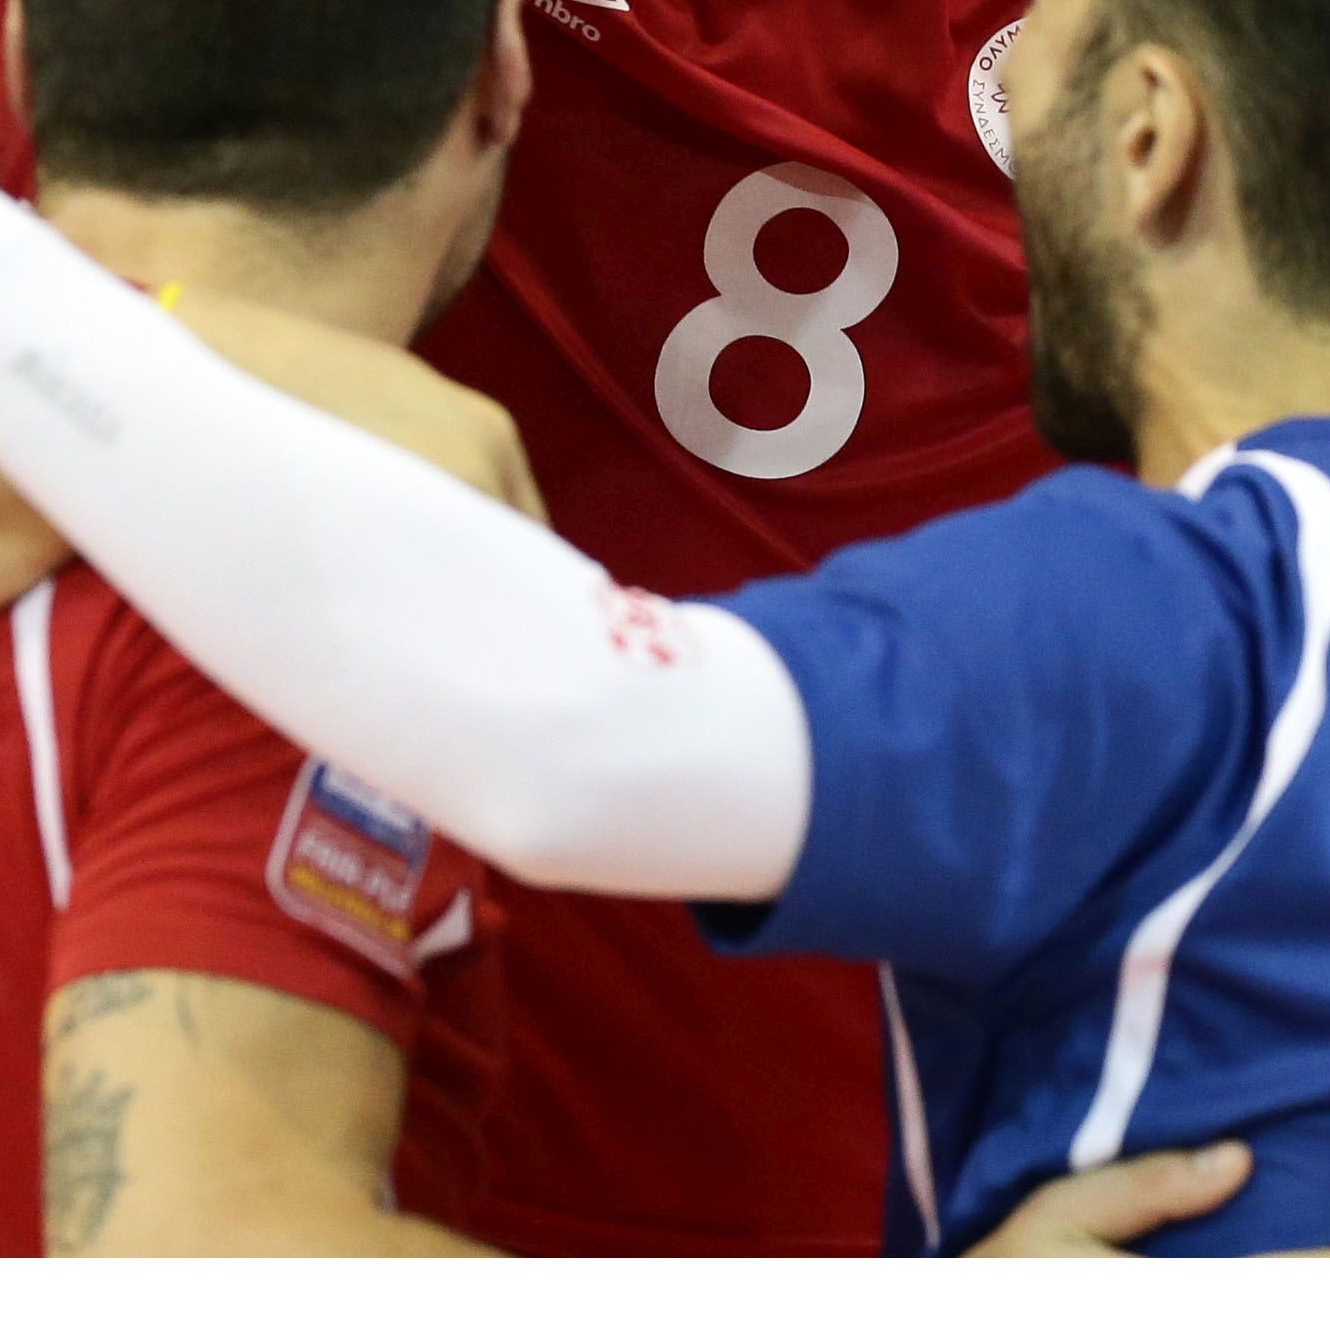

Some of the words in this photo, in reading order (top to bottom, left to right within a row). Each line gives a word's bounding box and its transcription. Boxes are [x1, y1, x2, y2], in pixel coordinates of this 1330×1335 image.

[979, 25, 1023, 71] ΟΛΥΜ
[972, 79, 1017, 173] ΣΥΝΔΕΣΜ
[654, 161, 899, 479] 8
